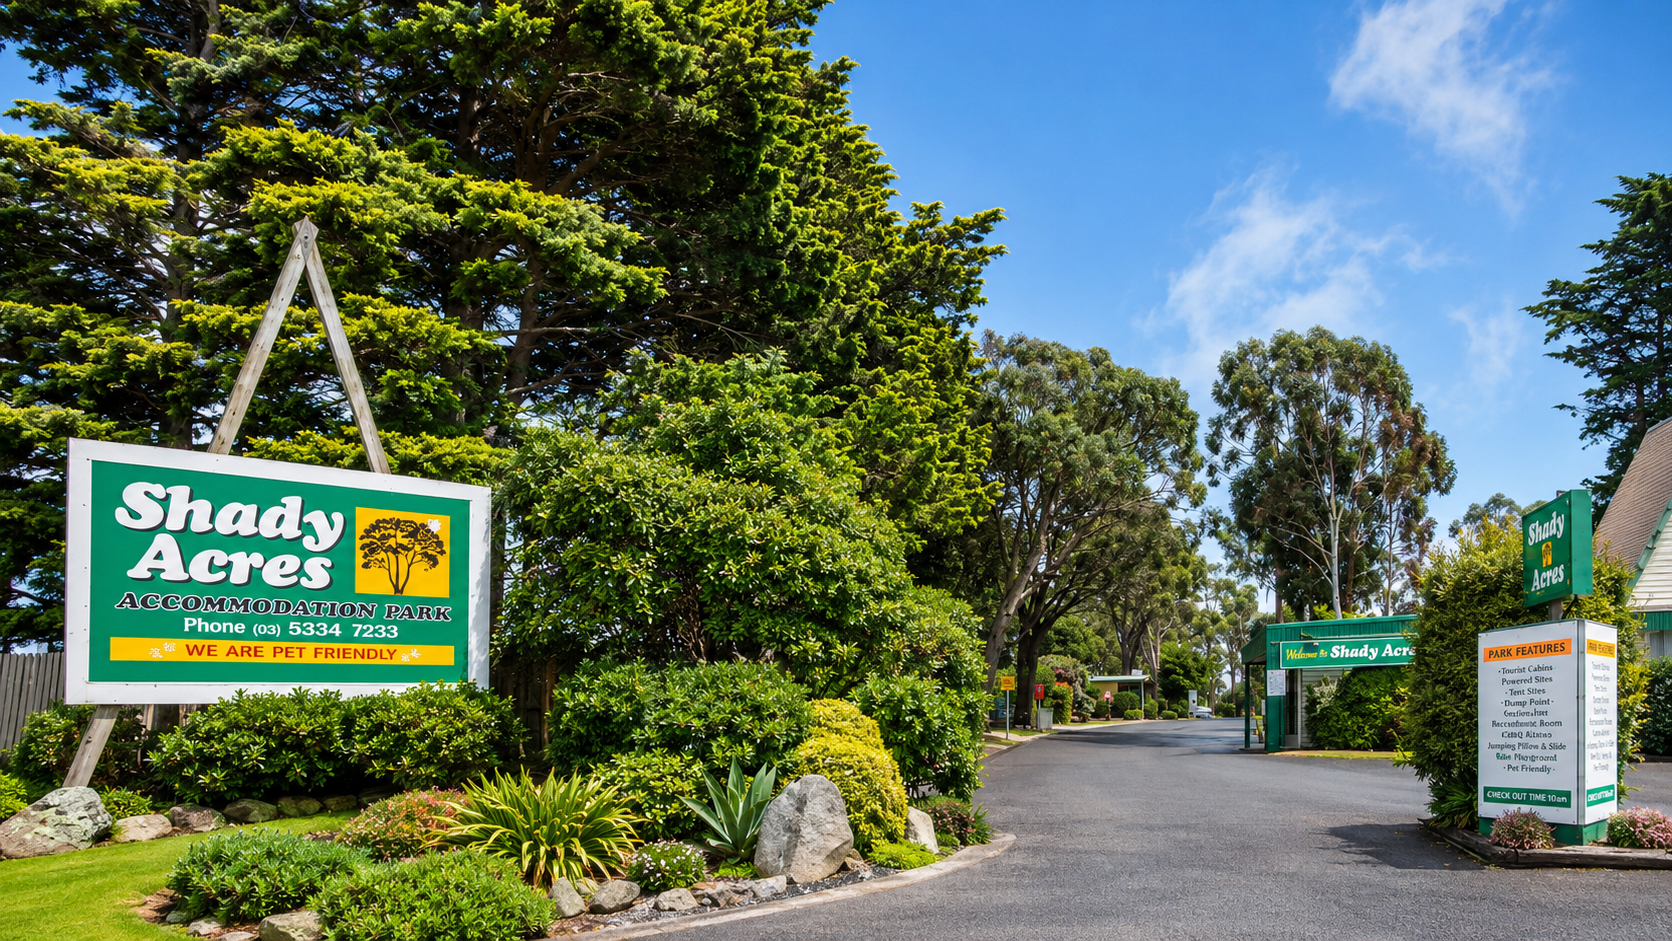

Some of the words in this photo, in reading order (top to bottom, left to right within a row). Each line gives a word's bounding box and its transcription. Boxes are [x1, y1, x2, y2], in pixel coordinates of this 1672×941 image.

[115, 481, 346, 553] Shady
[1528, 511, 1565, 546] Shady
[126, 532, 334, 590] Acres
[1531, 564, 1565, 592] Acres
[115, 591, 377, 620] ACCOMMODATION
[385, 603, 452, 622] PARK
[183, 617, 246, 635] Phone
[252, 623, 282, 637] (03)
[288, 622, 343, 637] 5334
[352, 624, 399, 639] 7233
[185, 644, 219, 658] WE
[225, 645, 265, 658] ARE
[272, 646, 306, 659] PET
[313, 647, 398, 661] FRIENDLY
[1330, 644, 1378, 660] Shady
[1382, 643, 1417, 657] Acre
[1489, 648, 1513, 659] PARK
[1516, 642, 1566, 656] FEATURES
[1528, 664, 1553, 673] Cabins
[1509, 688, 1525, 696] Tent
[1527, 687, 1546, 695] Sites
[1504, 699, 1527, 708] Dump
[1529, 698, 1550, 706] Point
[1507, 764, 1519, 772] Pet
[1521, 765, 1551, 774] Friendly
[1487, 790, 1510, 799] CHECK
[1512, 792, 1527, 800] OUT
[1529, 793, 1546, 801] TIME
